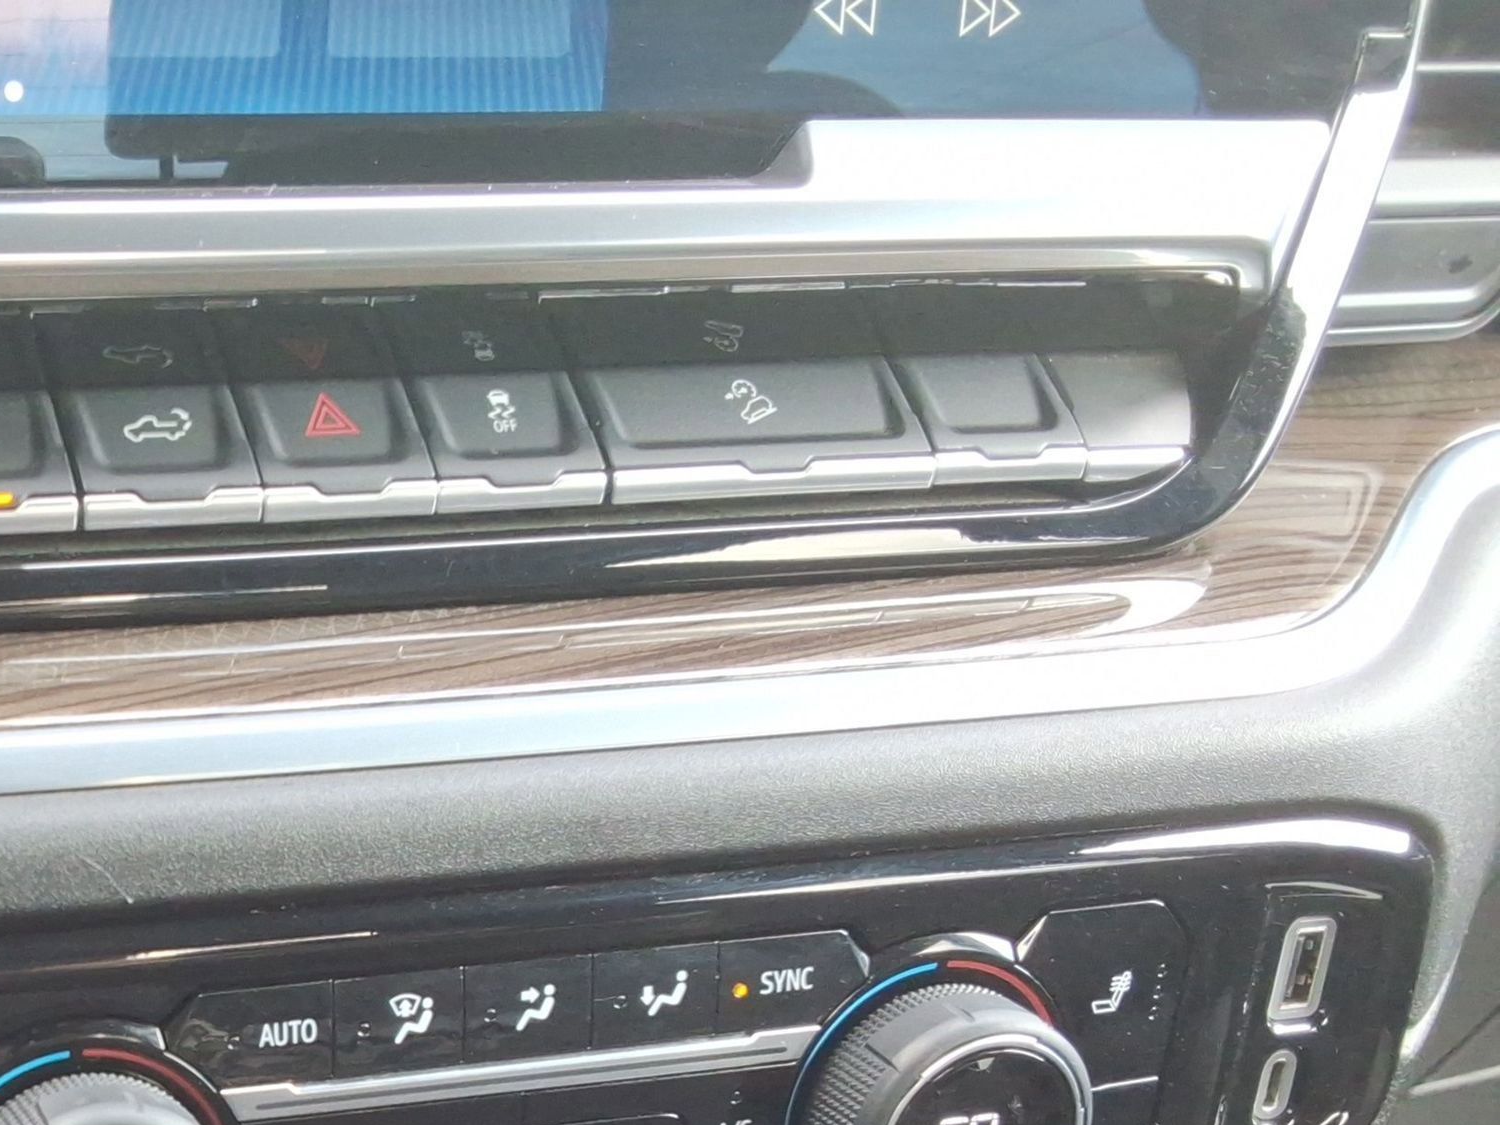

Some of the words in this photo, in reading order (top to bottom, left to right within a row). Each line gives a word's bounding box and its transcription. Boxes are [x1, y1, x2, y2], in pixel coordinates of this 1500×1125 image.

[493, 418, 518, 433] OFF
[759, 966, 814, 996] SYNC
[258, 1019, 318, 1049] AUTO
